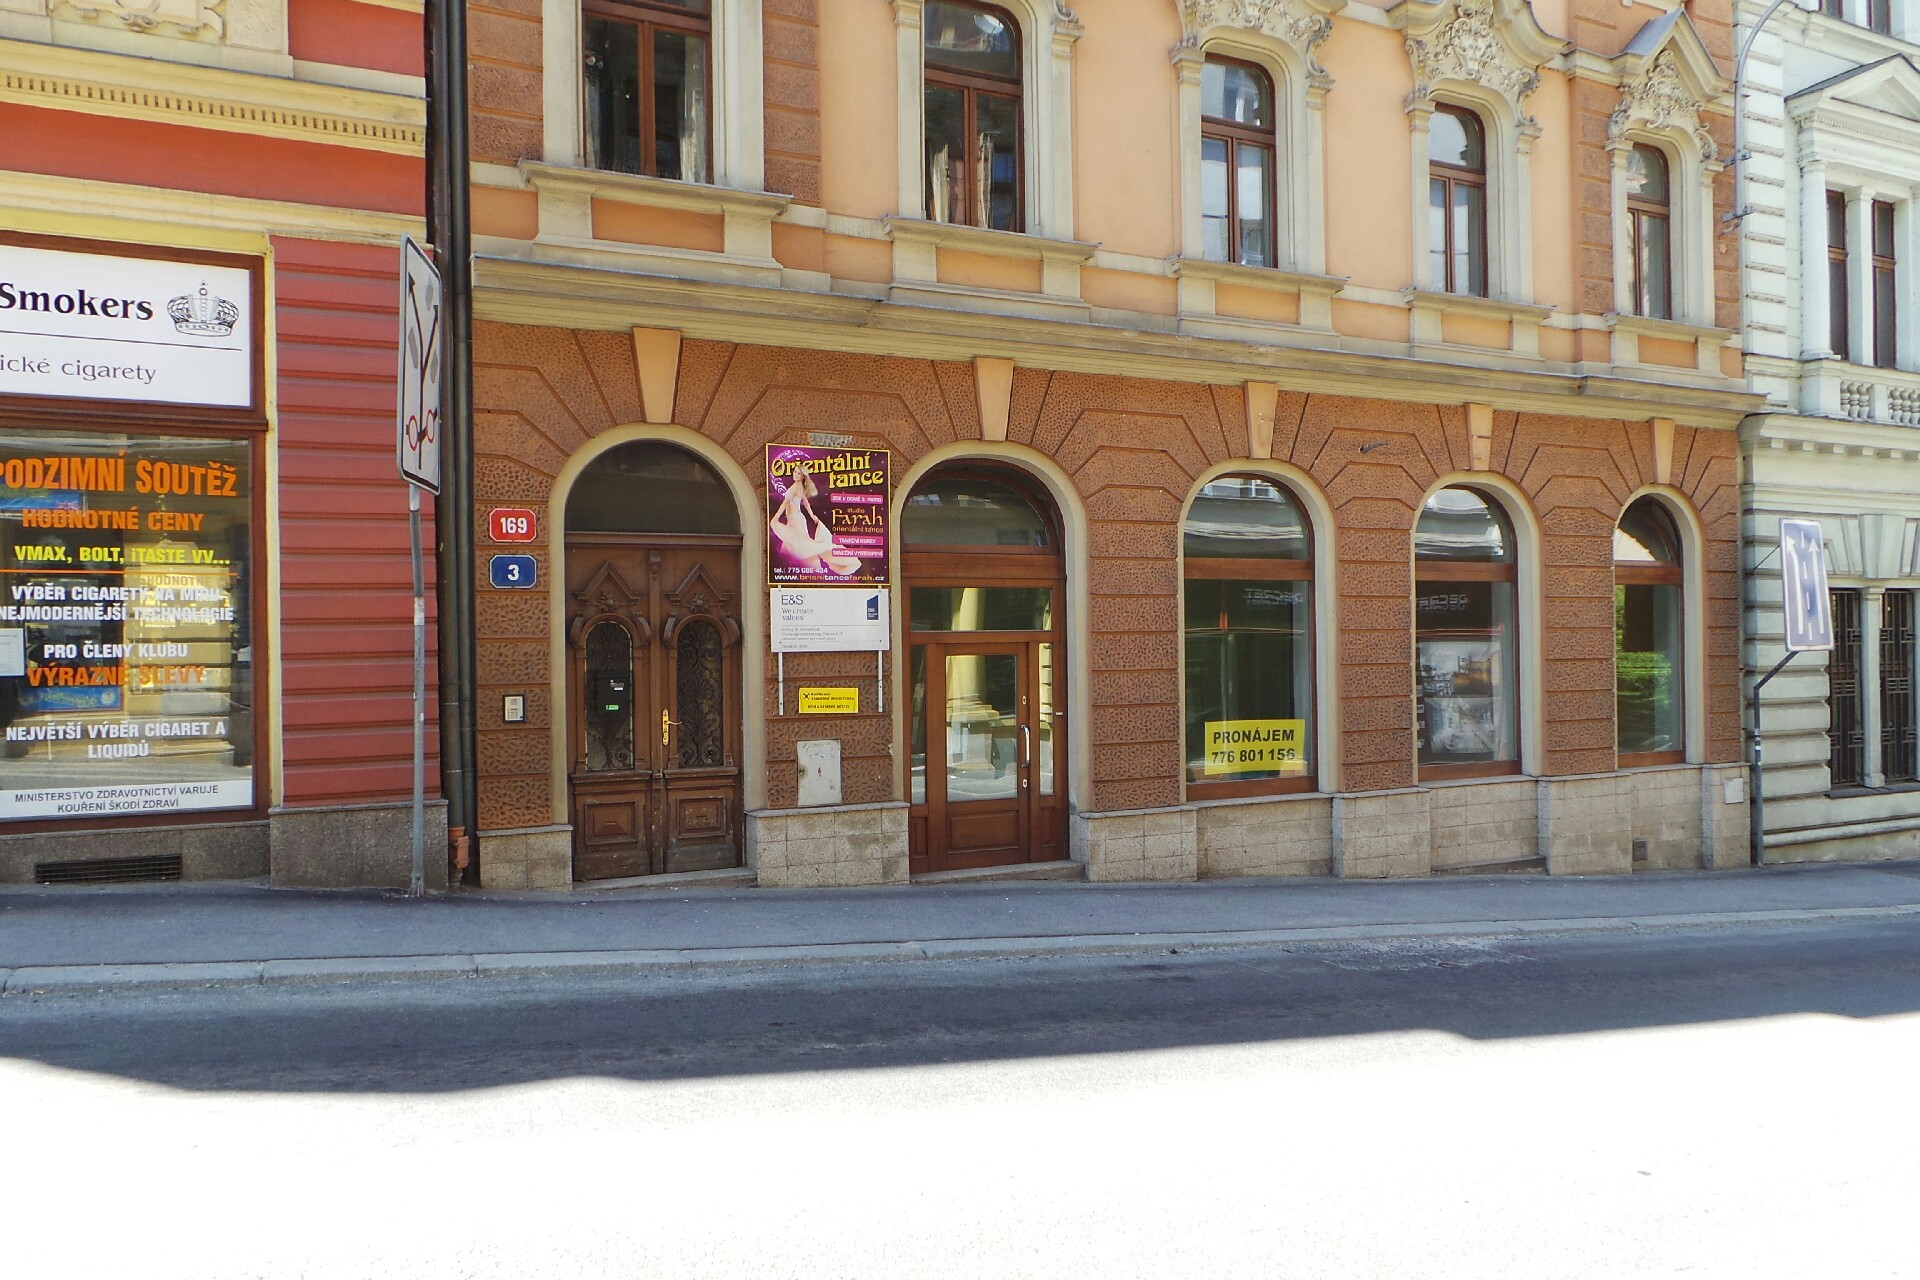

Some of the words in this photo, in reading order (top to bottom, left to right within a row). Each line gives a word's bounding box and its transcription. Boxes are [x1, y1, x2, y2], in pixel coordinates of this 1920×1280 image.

[0, 282, 154, 321] Smokers
[61, 359, 157, 385] cigarety
[0, 449, 125, 492] ODZIMNÍ
[135, 459, 238, 497] SOUTĚŽ
[771, 451, 871, 477] Orientální
[828, 470, 884, 489] tance
[22, 505, 139, 530] HODNOTNÉ
[147, 511, 204, 531] CENY
[832, 505, 884, 526] Farah
[500, 517, 528, 534] 169
[832, 525, 864, 533] orientální
[14, 545, 73, 564] VMAX,
[79, 546, 125, 565] BOLT,
[131, 547, 185, 564] iTASTE
[507, 564, 520, 581] 3
[12, 583, 66, 601] VÝBĚR
[71, 587, 149, 601] CIGARETY
[155, 588, 175, 601] NA
[781, 594, 804, 606] E&S
[0, 602, 127, 621] NEJMODERNĚJŠÍ
[133, 607, 235, 621] TECHNOLOGIE
[44, 644, 77, 659] PRO
[83, 640, 132, 659] ČLENY
[139, 644, 188, 658] KLUBU
[27, 661, 129, 687] VÝRAZNÉ
[139, 665, 205, 685] SLEVY
[6, 721, 83, 741] NEJVĚTŠÍ
[88, 720, 139, 739] VÝBĚR
[145, 722, 210, 738] CIGARET
[215, 721, 226, 735] A
[1213, 727, 1295, 744] PRONÁJEM
[88, 739, 149, 759] LIQUIDŮ
[1211, 750, 1235, 764] 776
[1240, 749, 1264, 762] 801
[15, 790, 94, 803] MINISTERSTVO
[96, 784, 177, 799] ZDRAVOTNICTVÍ
[179, 785, 219, 796] VARUJE
[57, 801, 106, 813] KOUŘENÍ
[109, 798, 140, 811] ŠKODÍ
[142, 797, 179, 809] ZDRAVÍ
